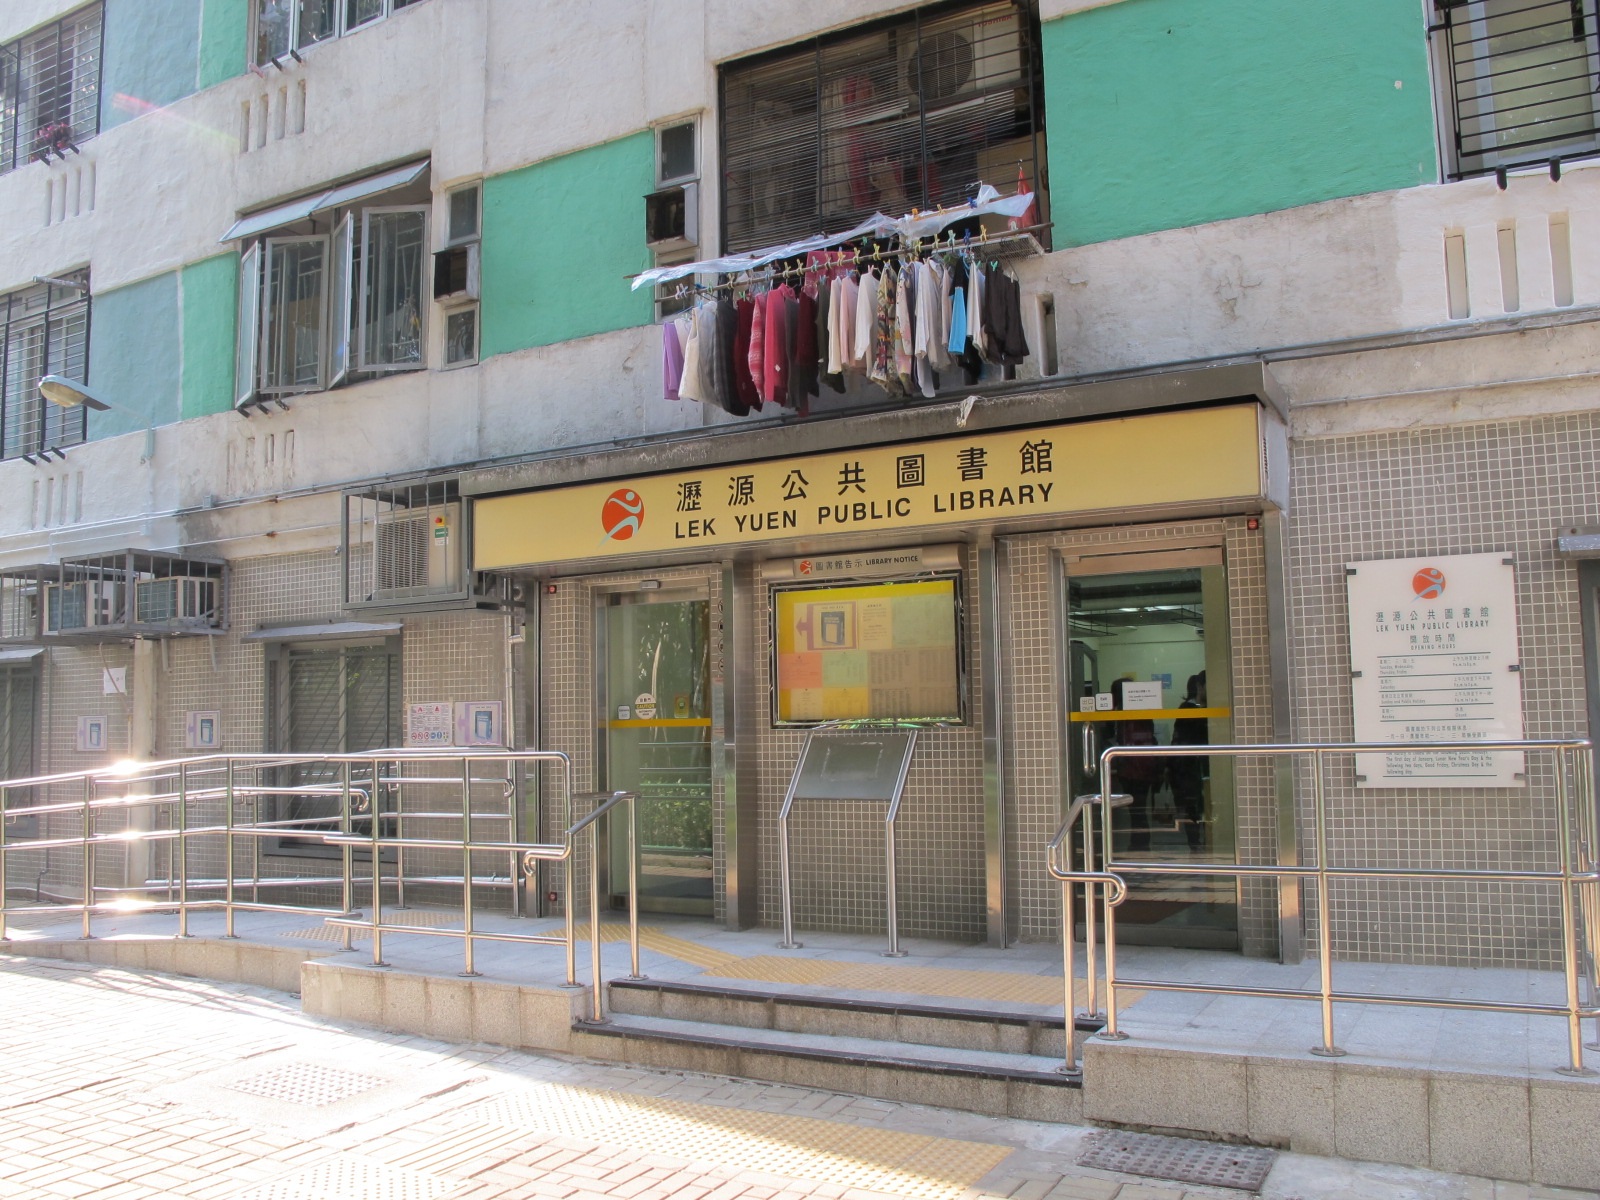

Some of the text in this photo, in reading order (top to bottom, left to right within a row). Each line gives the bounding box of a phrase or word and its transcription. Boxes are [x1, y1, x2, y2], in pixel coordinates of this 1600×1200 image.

[676, 439, 1053, 512] 瀝源公共圖書館
[675, 482, 1053, 539] LEK YUEN PUBLIC LIBRARY
[816, 558, 863, 570] 圖書館告示
[866, 558, 892, 566] LIBRARY
[1376, 606, 1488, 622] 瀝源公共圖書館
[1422, 622, 1449, 630] PUBLIC
[1456, 620, 1488, 628] LIBRARY
[1410, 633, 1455, 643] 開放時間
